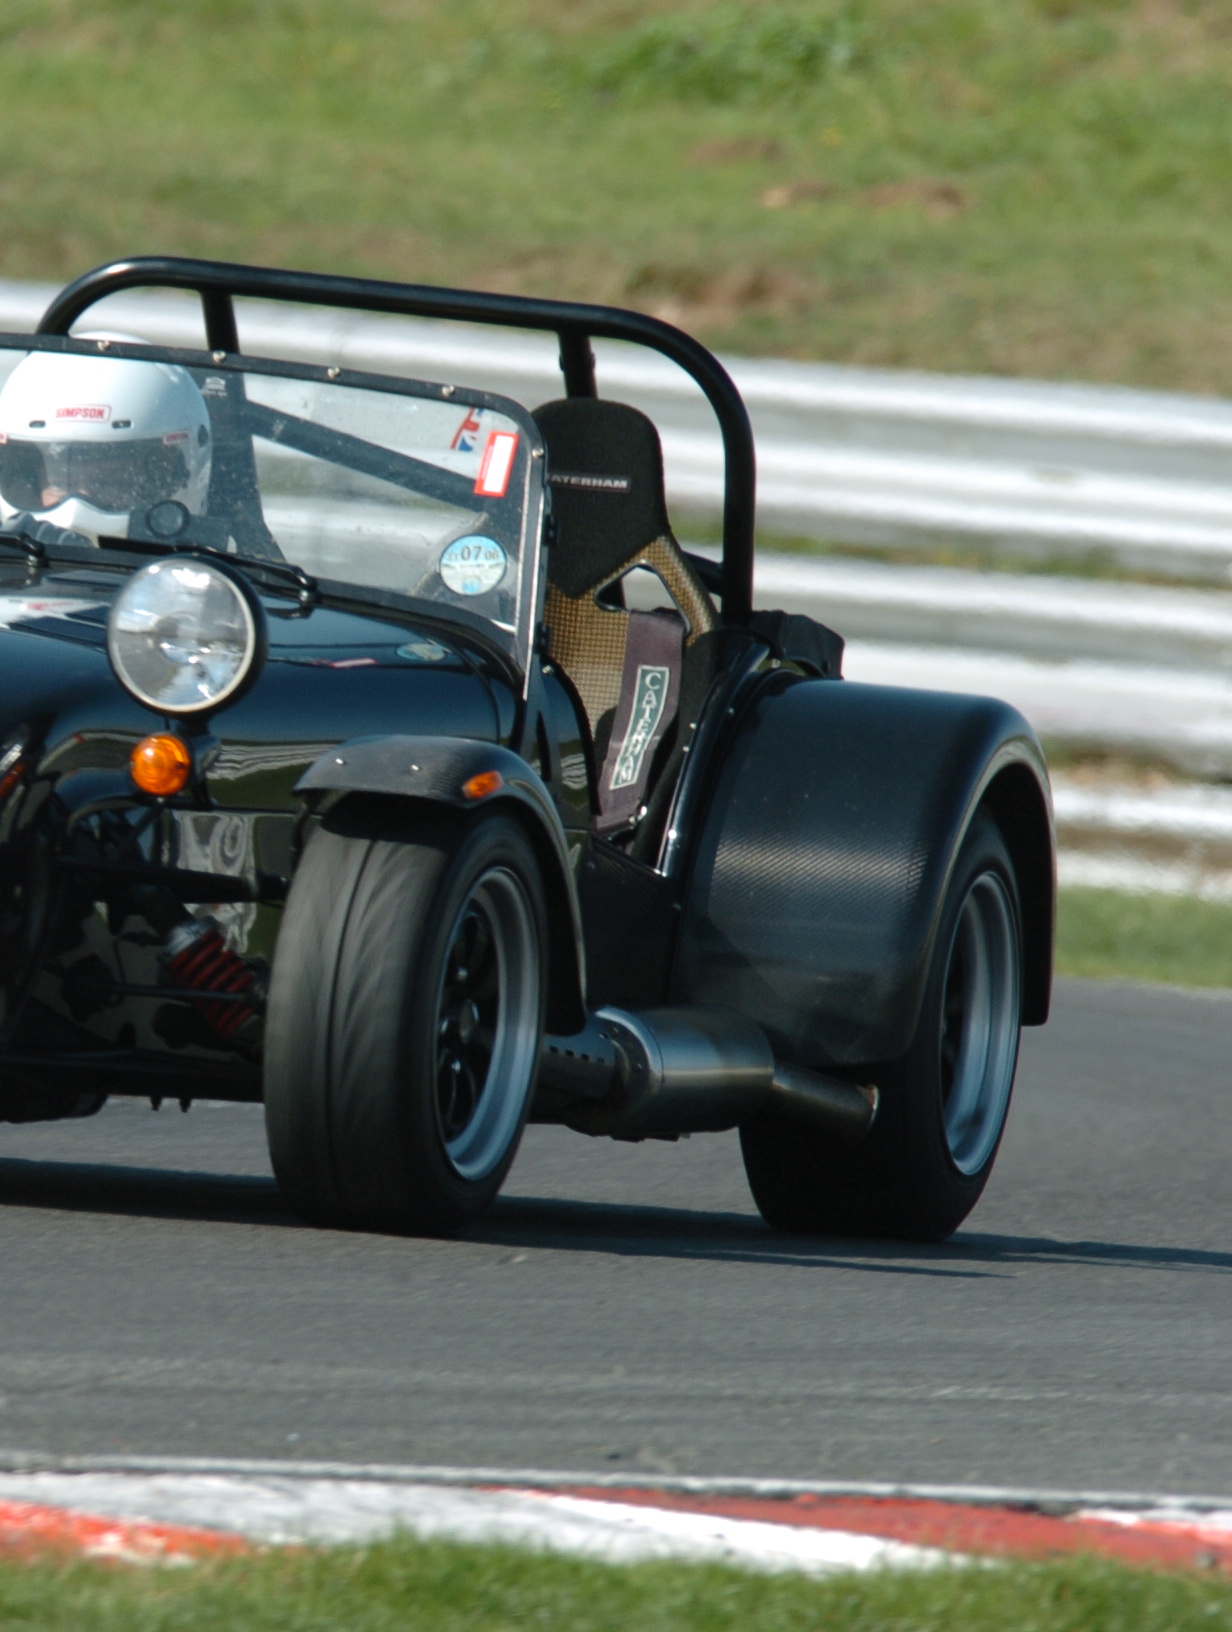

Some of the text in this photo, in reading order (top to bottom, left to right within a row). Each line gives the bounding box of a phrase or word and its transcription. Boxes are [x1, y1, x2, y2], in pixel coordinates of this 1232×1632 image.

[56, 407, 105, 419] SIMPSON
[548, 474, 628, 489] ATERHAM
[461, 545, 482, 561] 07
